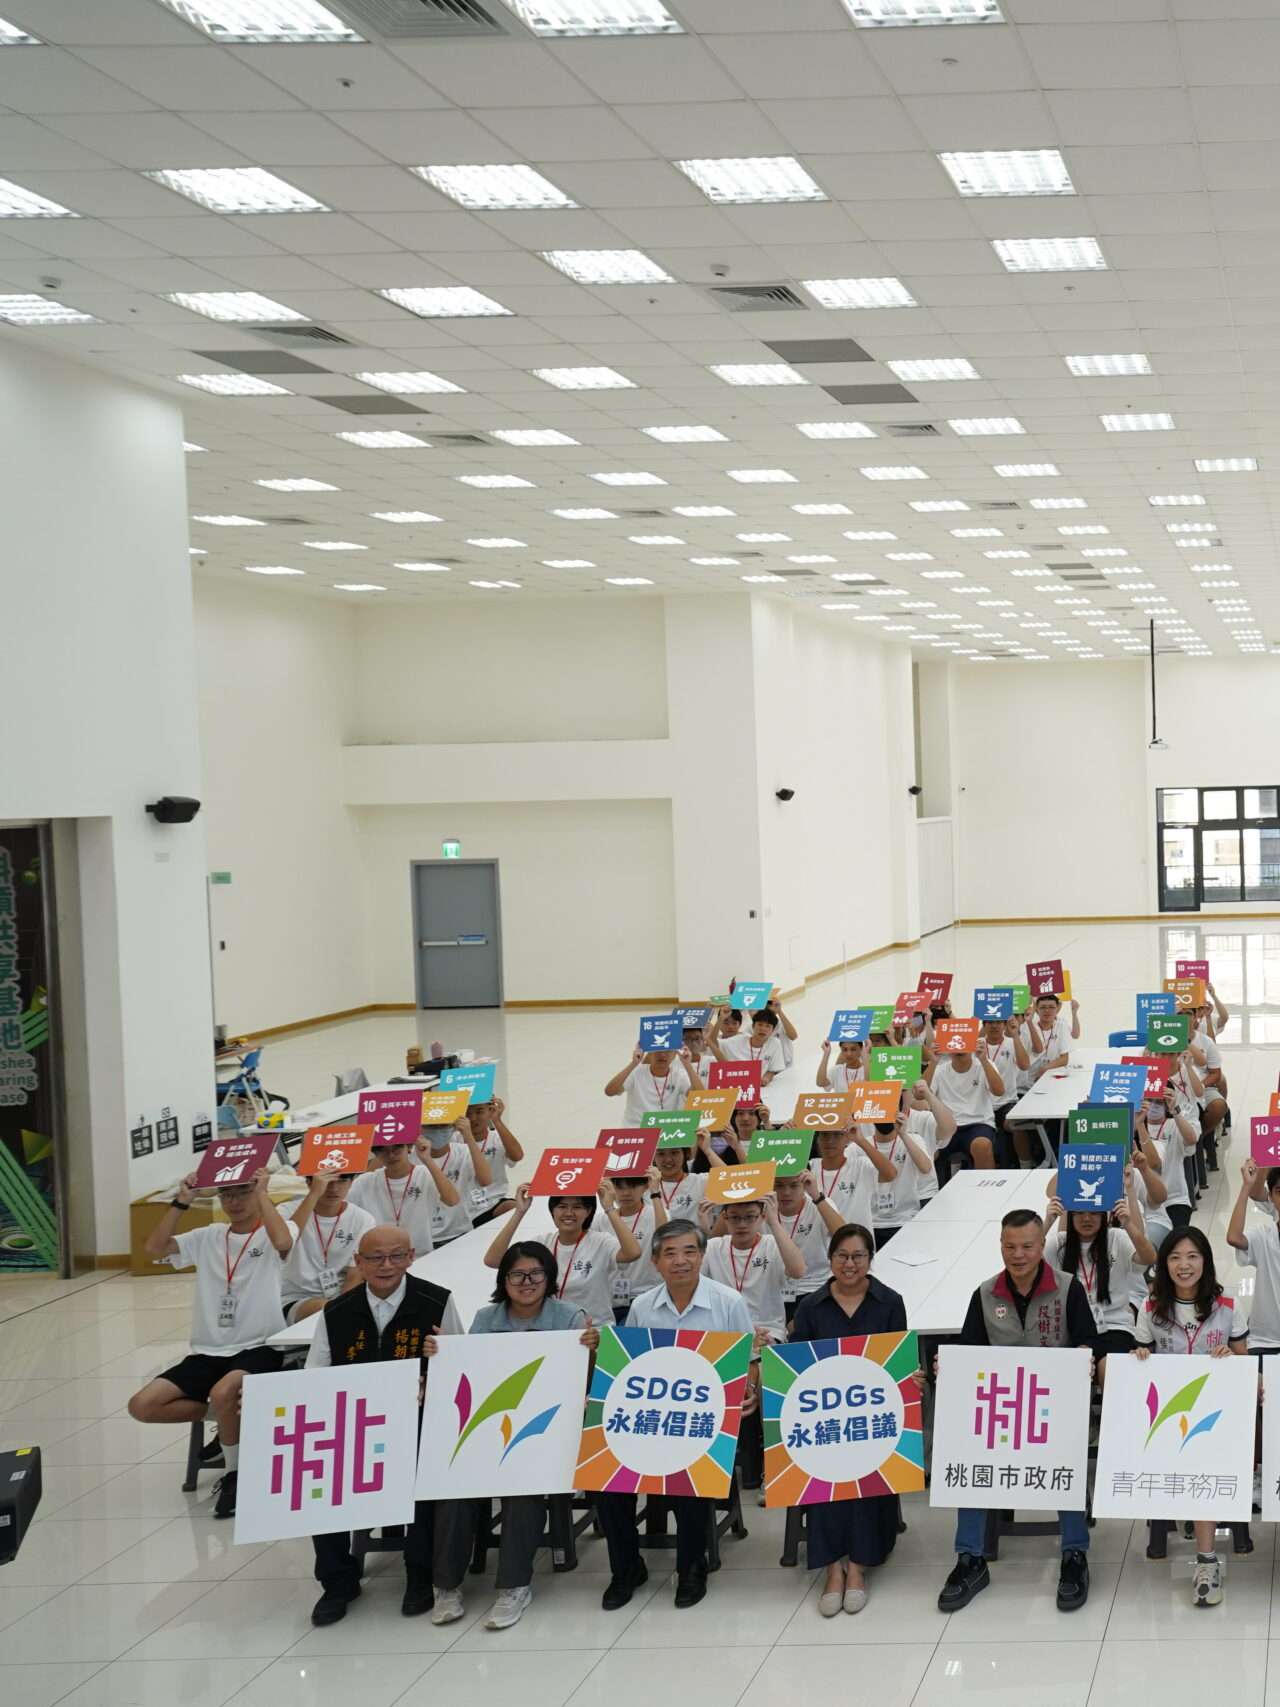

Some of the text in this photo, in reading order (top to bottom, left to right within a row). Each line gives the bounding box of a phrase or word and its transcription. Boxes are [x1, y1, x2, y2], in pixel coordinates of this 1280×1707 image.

[643, 1021, 652, 1030] 16
[878, 1053, 888, 1063] 15
[446, 1074, 454, 1084] 6
[718, 1069, 723, 1080] 1
[1099, 1070, 1110, 1081] 14
[855, 1087, 864, 1098] 11
[363, 1100, 376, 1113] 10
[692, 1096, 701, 1106] 2
[804, 1098, 815, 1107] 12
[647, 1116, 656, 1126] 3
[1075, 1119, 1088, 1133] 13
[1255, 1123, 1269, 1136] 10
[313, 1134, 322, 1145] 9
[605, 1136, 615, 1147] 4
[756, 1137, 765, 1149] 3
[214, 1146, 226, 1157] 8
[549, 1155, 560, 1166] 5
[1063, 1154, 1077, 1169] 16
[718, 1170, 727, 1181] 2
[625, 1375, 711, 1404] SDGs
[799, 1384, 885, 1413] SDGs
[607, 1407, 715, 1440] 永續倡議
[787, 1412, 898, 1449] 永續倡議
[944, 1463, 1075, 1491] 桃園市政府
[1111, 1471, 1239, 1500] 青年事務局
